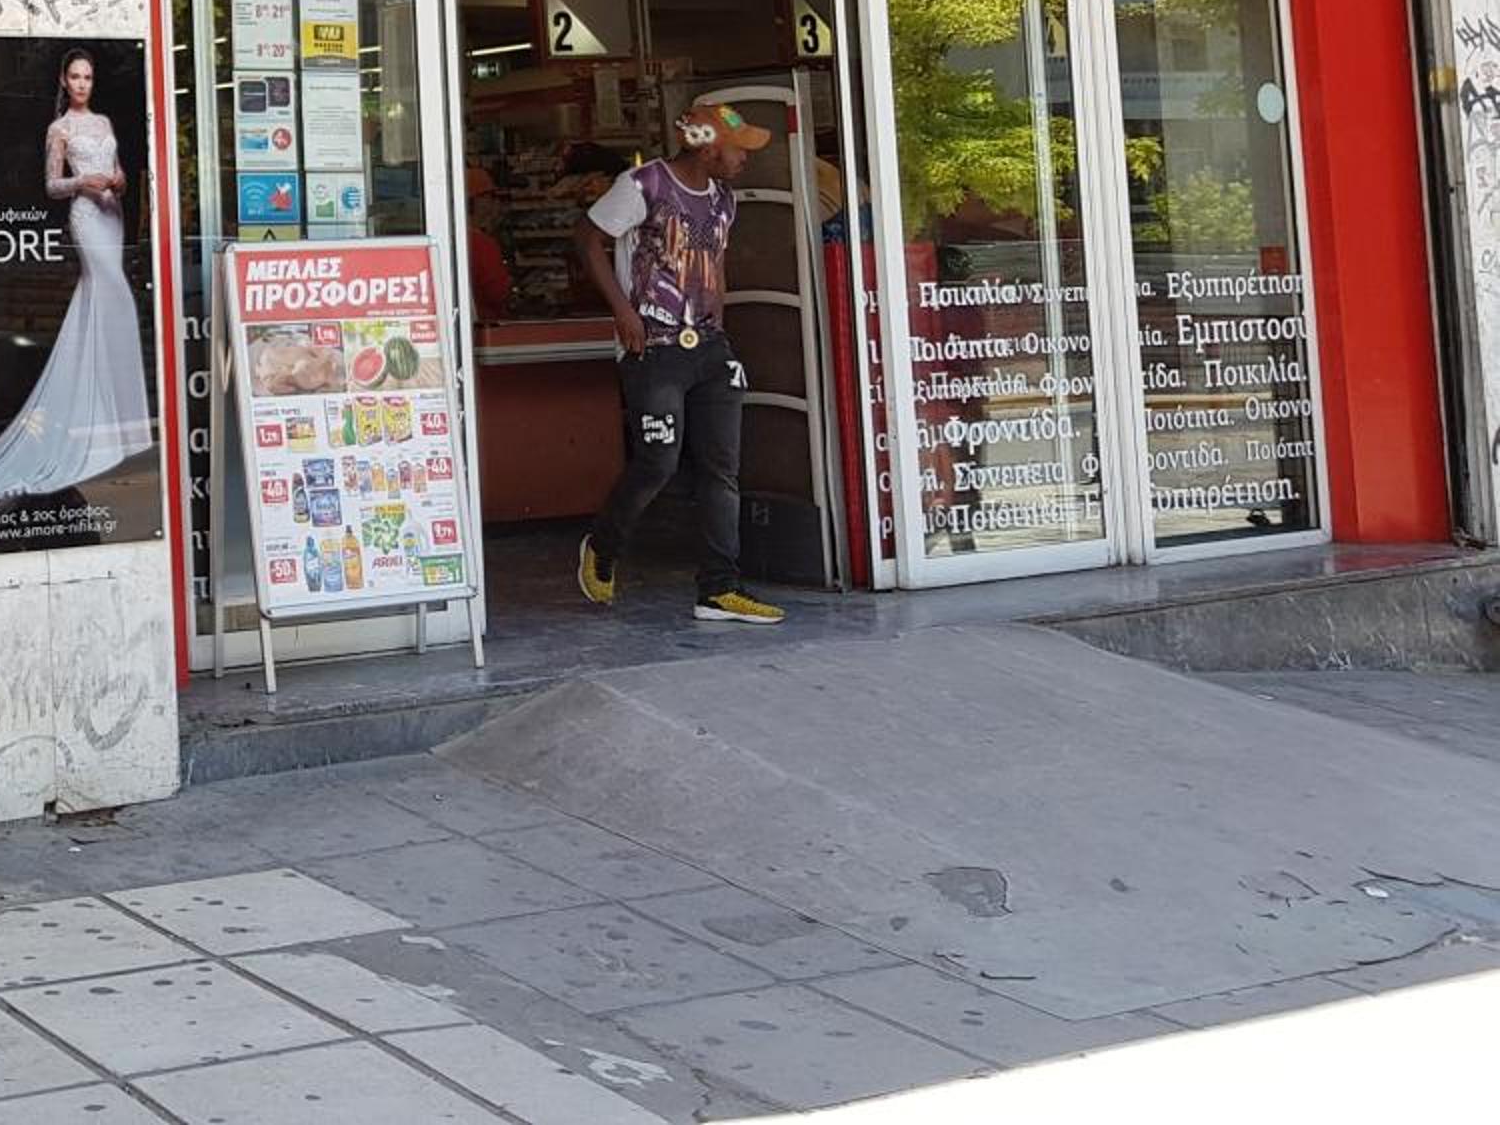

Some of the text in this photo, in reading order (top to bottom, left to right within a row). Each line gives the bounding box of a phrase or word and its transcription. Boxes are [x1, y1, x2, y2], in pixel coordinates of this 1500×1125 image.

[553, 11, 819, 53] 2 3
[246, 257, 342, 282] ΜΕΓΑΛΕΣ
[245, 269, 429, 312] ΠΡΟΣΦΟΡΕΣ!
[1204, 354, 1307, 388] Ποικιλία.
[944, 408, 1081, 454] Φροντίδα.
[59, 503, 110, 523] όροφος
